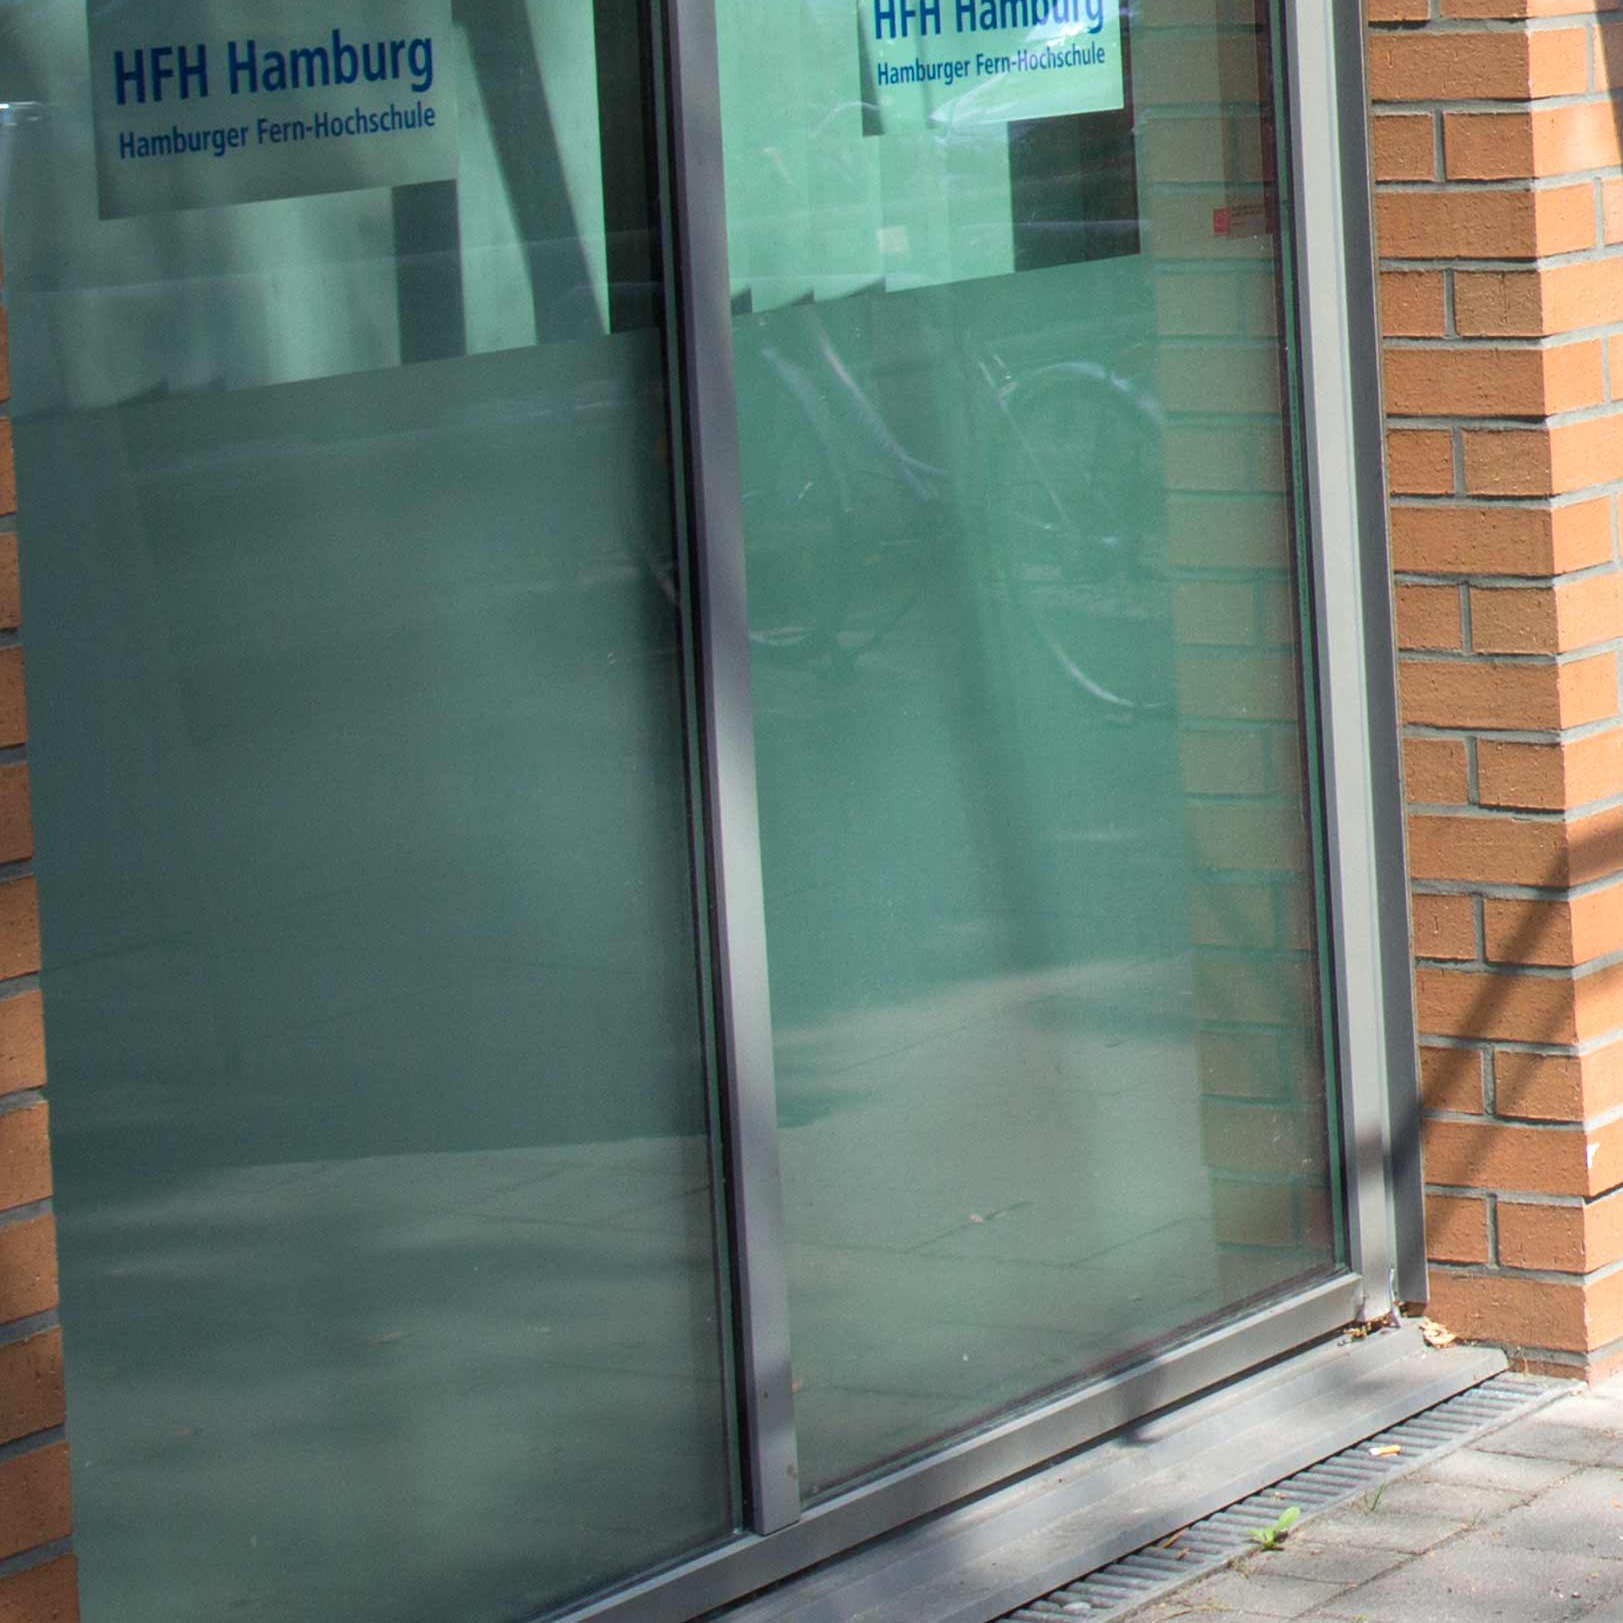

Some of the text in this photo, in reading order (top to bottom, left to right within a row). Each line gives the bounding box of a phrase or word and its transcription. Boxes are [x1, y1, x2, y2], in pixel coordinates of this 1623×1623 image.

[114, 29, 434, 106] HFH Hamburg
[877, 42, 1105, 87] Hamburger Fern-Hochschule
[119, 101, 436, 160] Hamburger Fern-Hochschule
